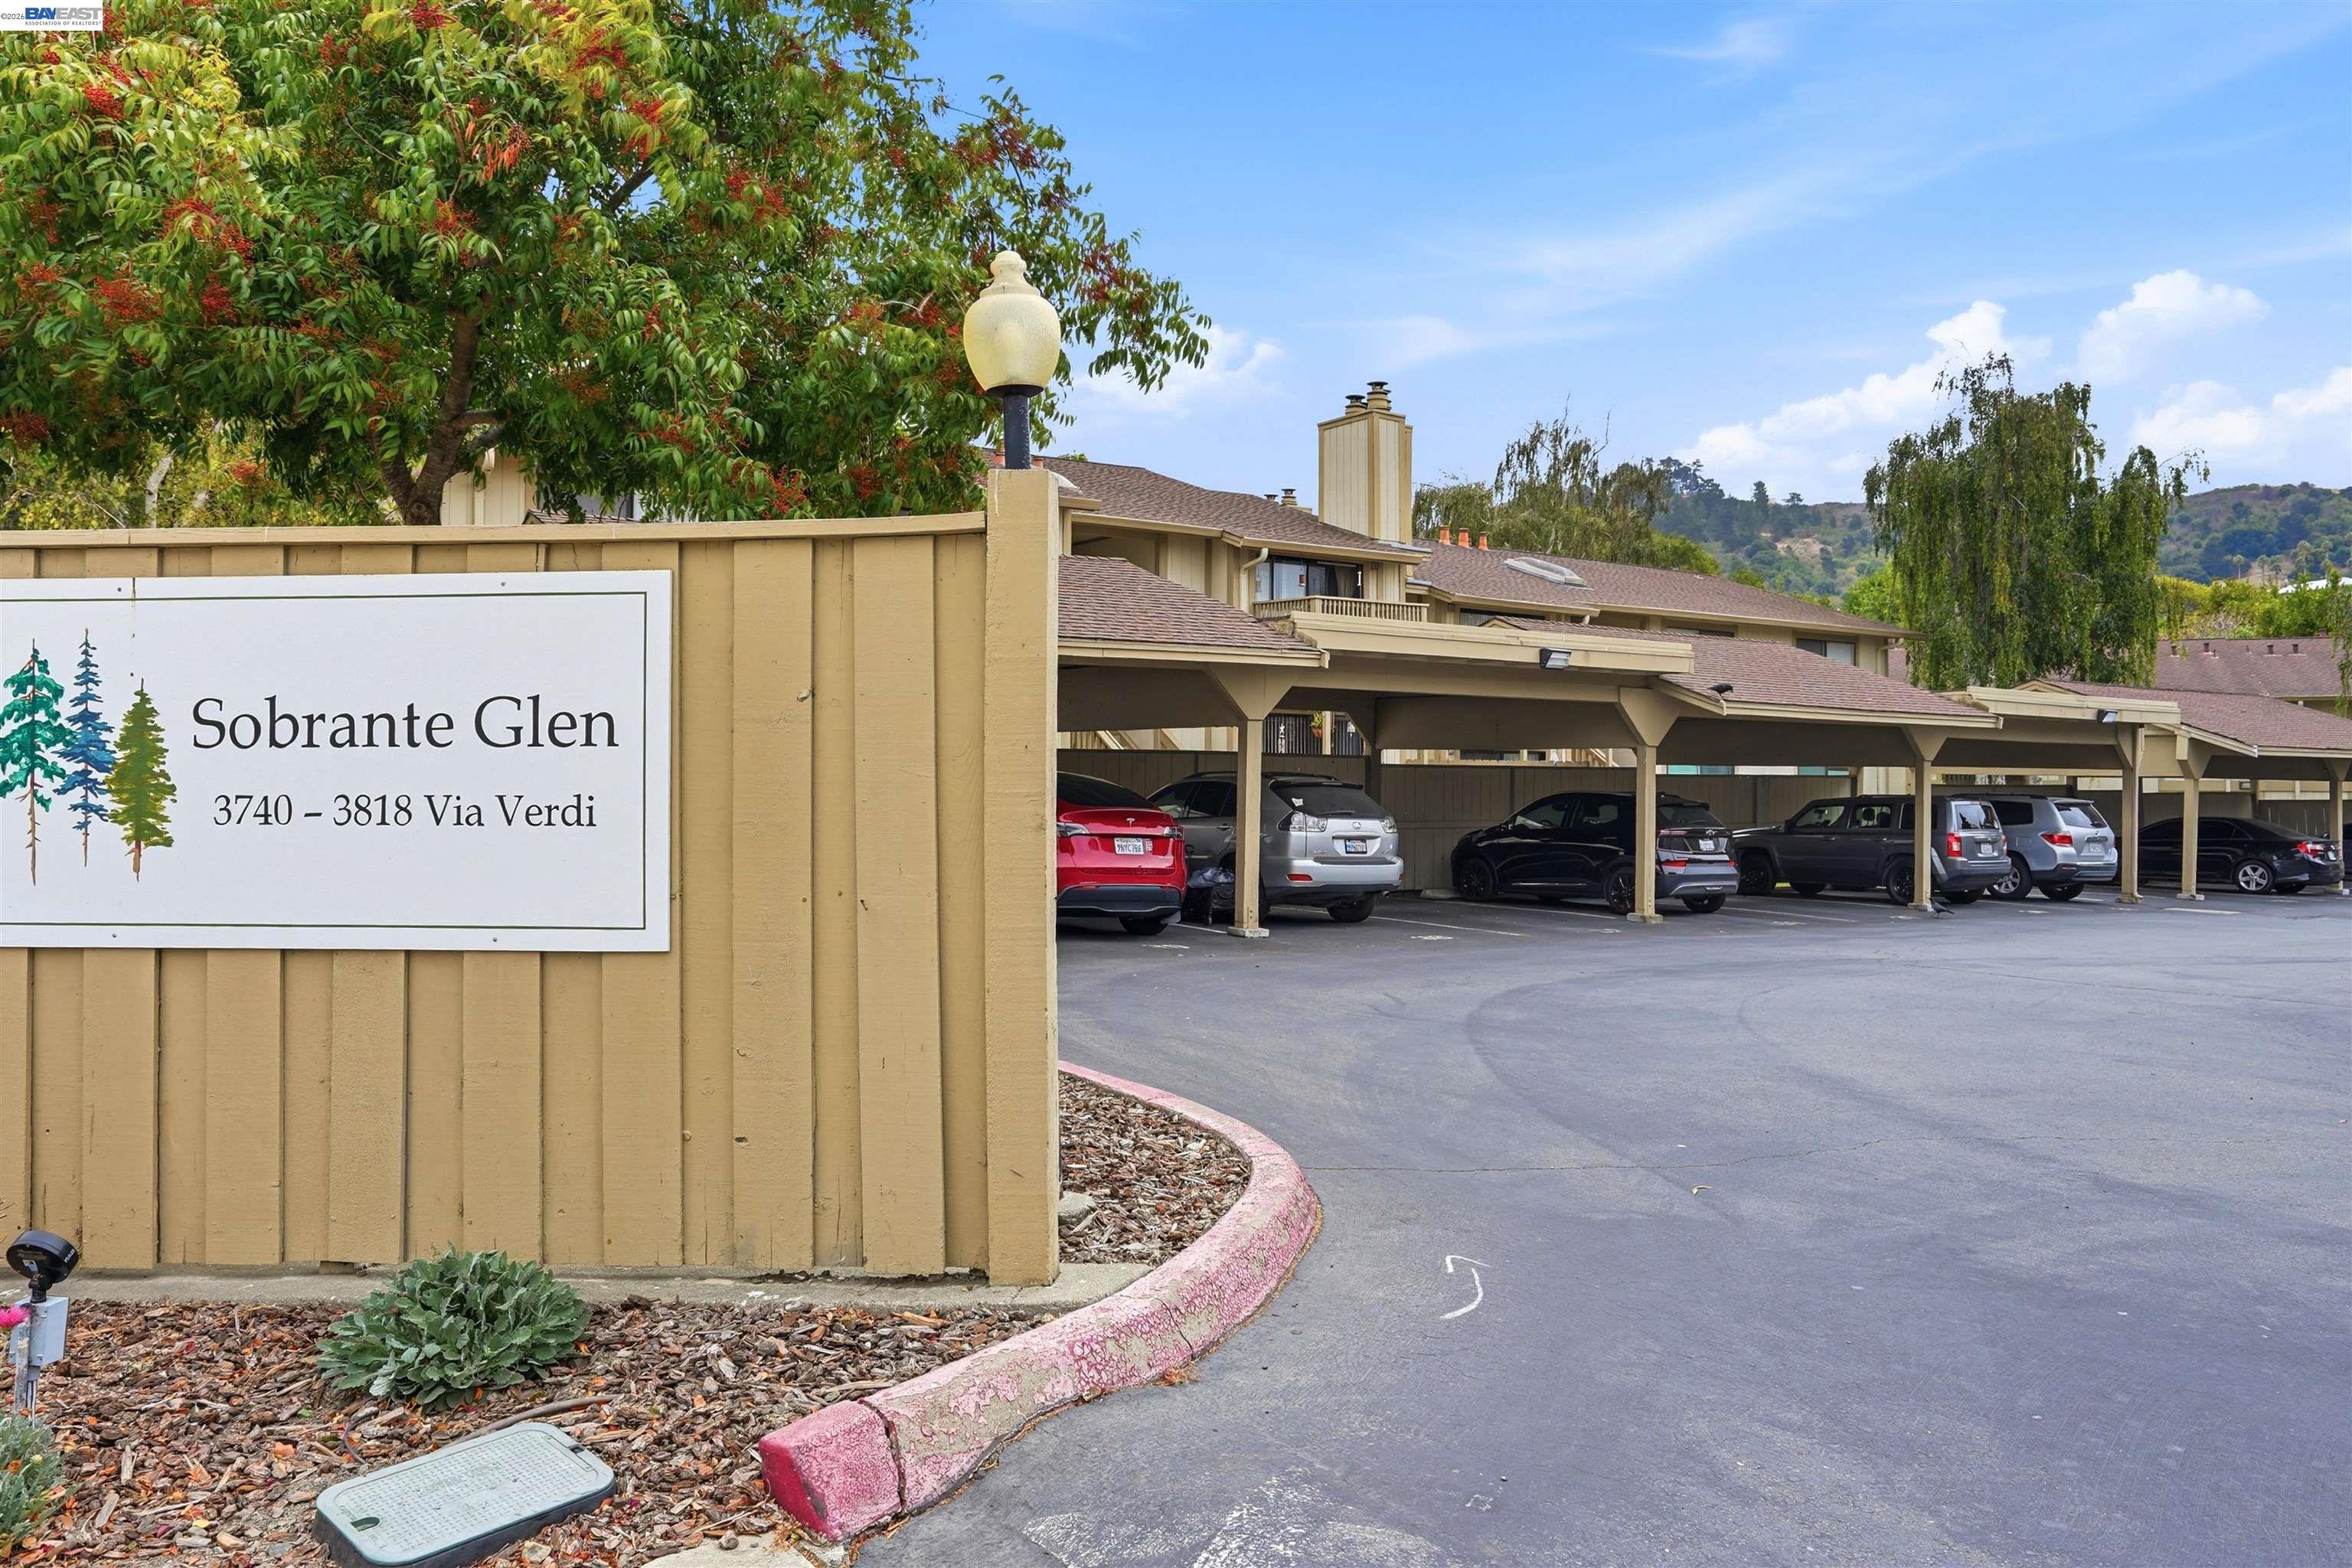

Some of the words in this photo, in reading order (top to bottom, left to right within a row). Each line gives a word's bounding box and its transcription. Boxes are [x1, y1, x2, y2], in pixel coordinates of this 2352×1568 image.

[192, 694, 454, 750] Sobrante
[474, 694, 619, 748] Glen
[214, 794, 292, 826] 3740
[333, 794, 413, 827] 3818
[423, 794, 485, 827] Via
[495, 793, 597, 827] Verdi
